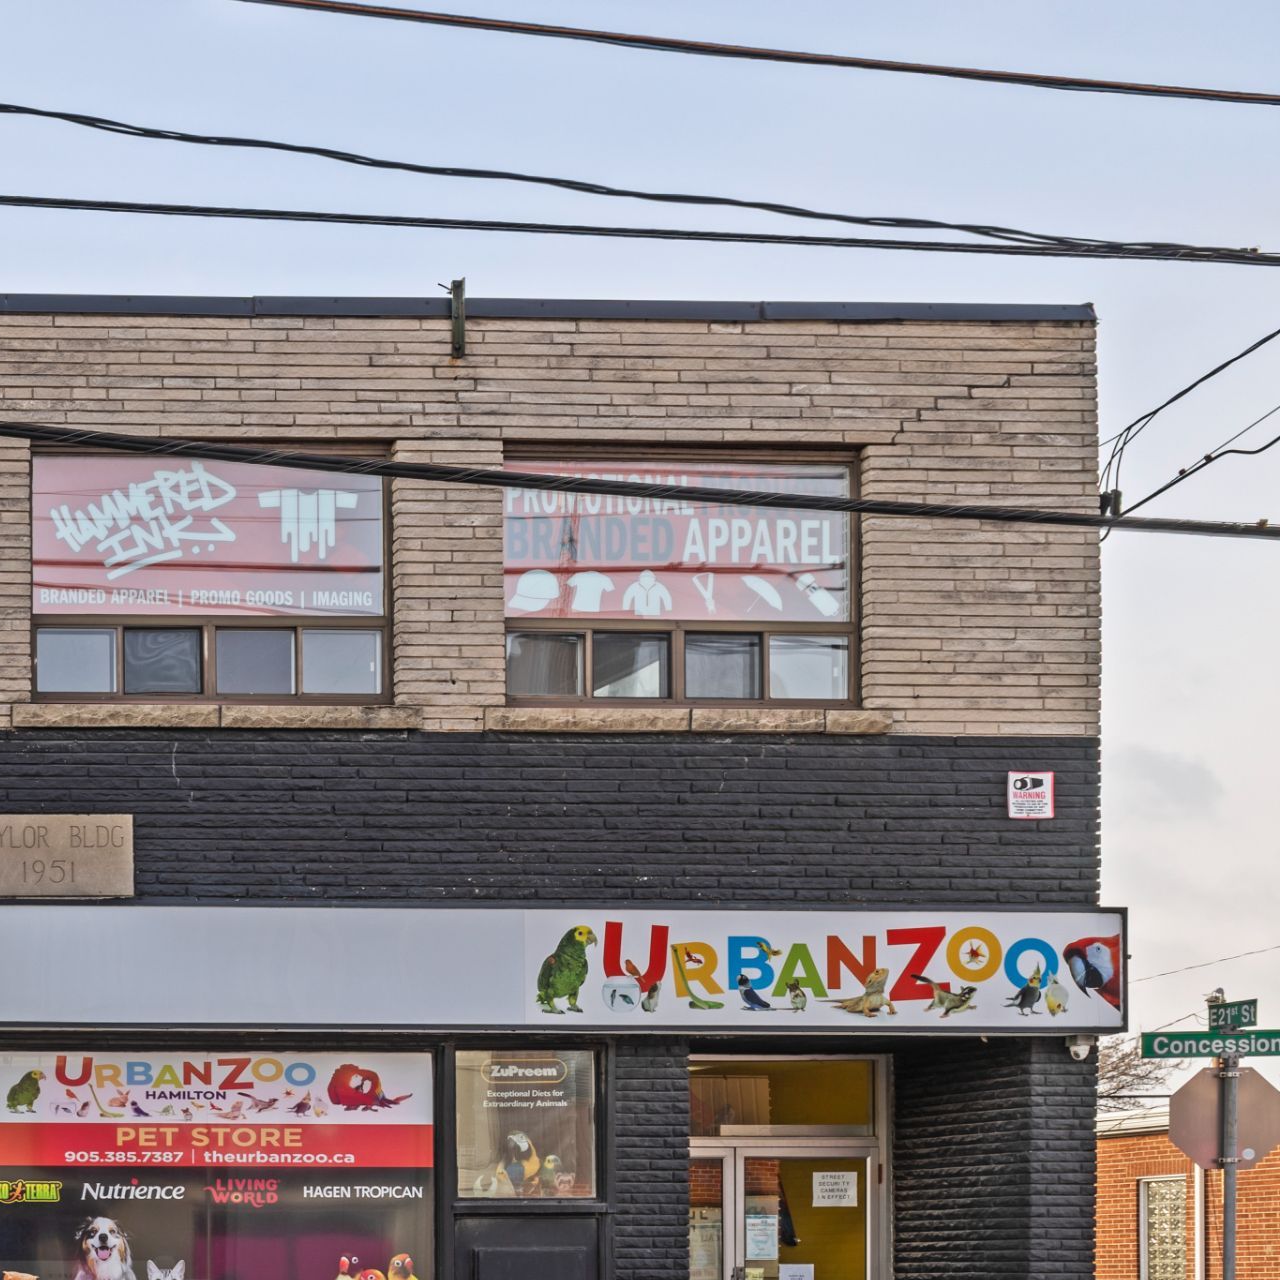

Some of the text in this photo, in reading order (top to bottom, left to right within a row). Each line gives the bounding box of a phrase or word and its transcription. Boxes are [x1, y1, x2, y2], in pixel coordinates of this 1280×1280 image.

[506, 471, 694, 516] PROMOTIONAL
[50, 460, 237, 552] HAMMERED
[97, 516, 236, 568] INK
[506, 515, 840, 564] BRANDED APPAREL
[40, 588, 373, 607] BRANDED APPAREL PROMO GOODS IMAGING
[1013, 791, 1046, 799] WARNING
[68, 825, 124, 848] BLDG
[22, 860, 75, 886] 1951
[602, 921, 1059, 1001] URBANZOO
[1241, 1004, 1255, 1023] St
[1153, 1035, 1280, 1055] Concession
[55, 1055, 316, 1090] URBANZOO
[490, 1065, 557, 1077] ZuPreem
[145, 1090, 227, 1101] HAMILTON
[487, 1089, 565, 1099] Exceptional Diets for
[483, 1100, 534, 1109] Extraordinary
[116, 1127, 304, 1147] PET STORE
[64, 1150, 356, 1164] 905.385.7387 theurbanzoo.ca
[25, 1182, 59, 1199] TERRA
[81, 1178, 185, 1200] Nutrience
[216, 1179, 279, 1191] LIVING
[303, 1186, 423, 1198] HAGEN TROPICAN
[205, 1187, 278, 1208] WORLD
